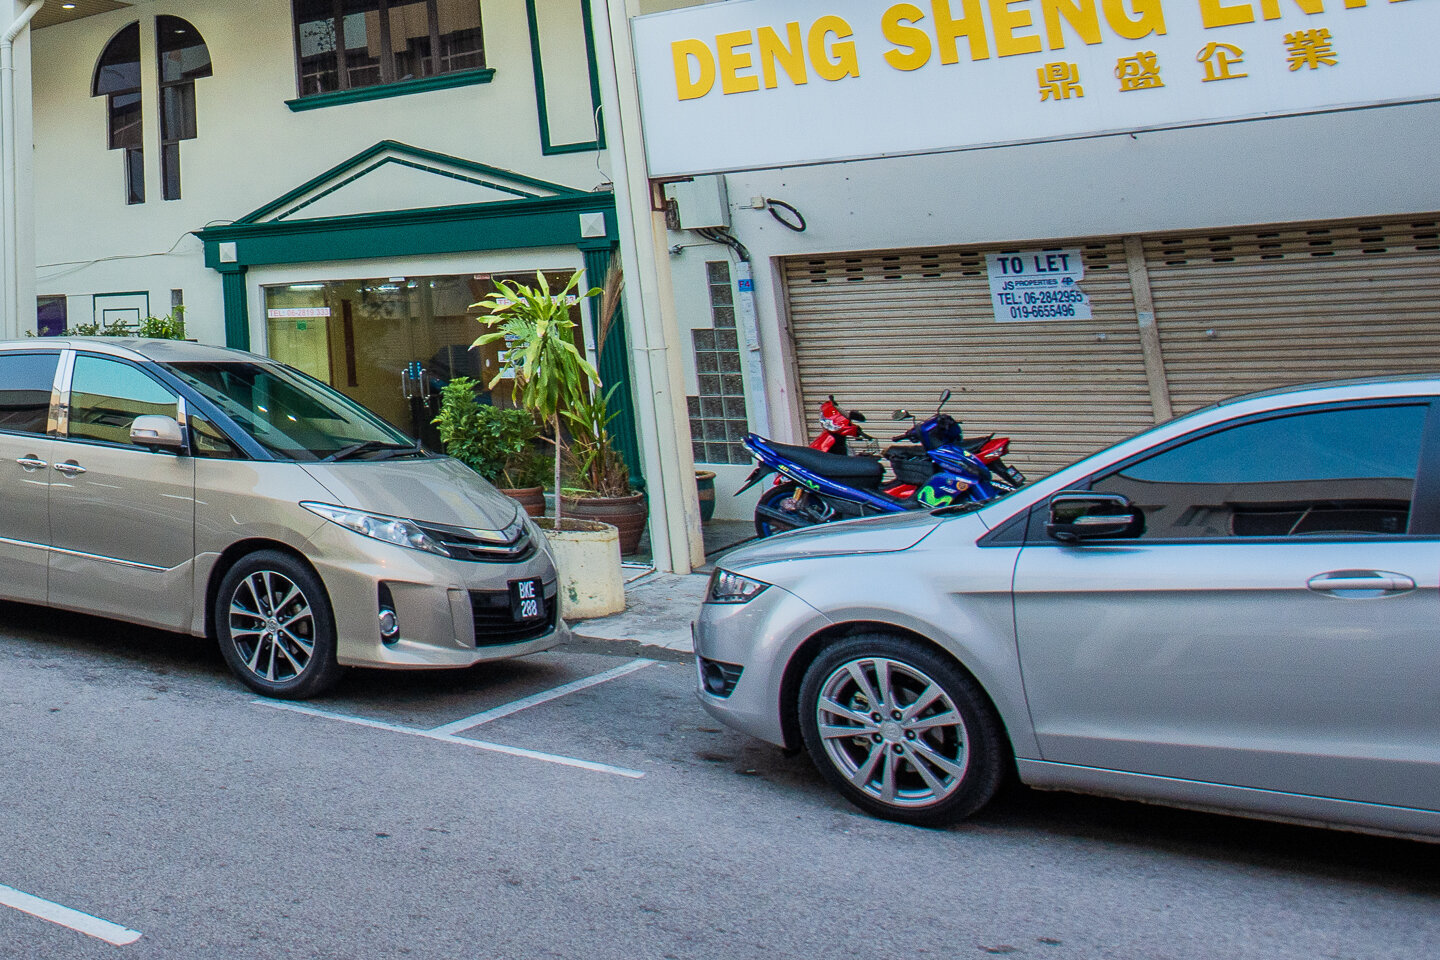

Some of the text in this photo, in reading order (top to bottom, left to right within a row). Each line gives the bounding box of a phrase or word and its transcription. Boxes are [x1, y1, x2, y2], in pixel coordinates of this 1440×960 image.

[672, 16, 860, 101] DENG
[1036, 27, 1338, 102] 鼎盛企業
[996, 253, 1070, 274] TO LET
[1002, 279, 1058, 290] JS PROPERTIES
[997, 290, 1083, 305] TEL: 06-2842955
[1010, 303, 1075, 319] 019-6655496
[518, 581, 536, 598] BKE
[521, 600, 537, 617] 288
